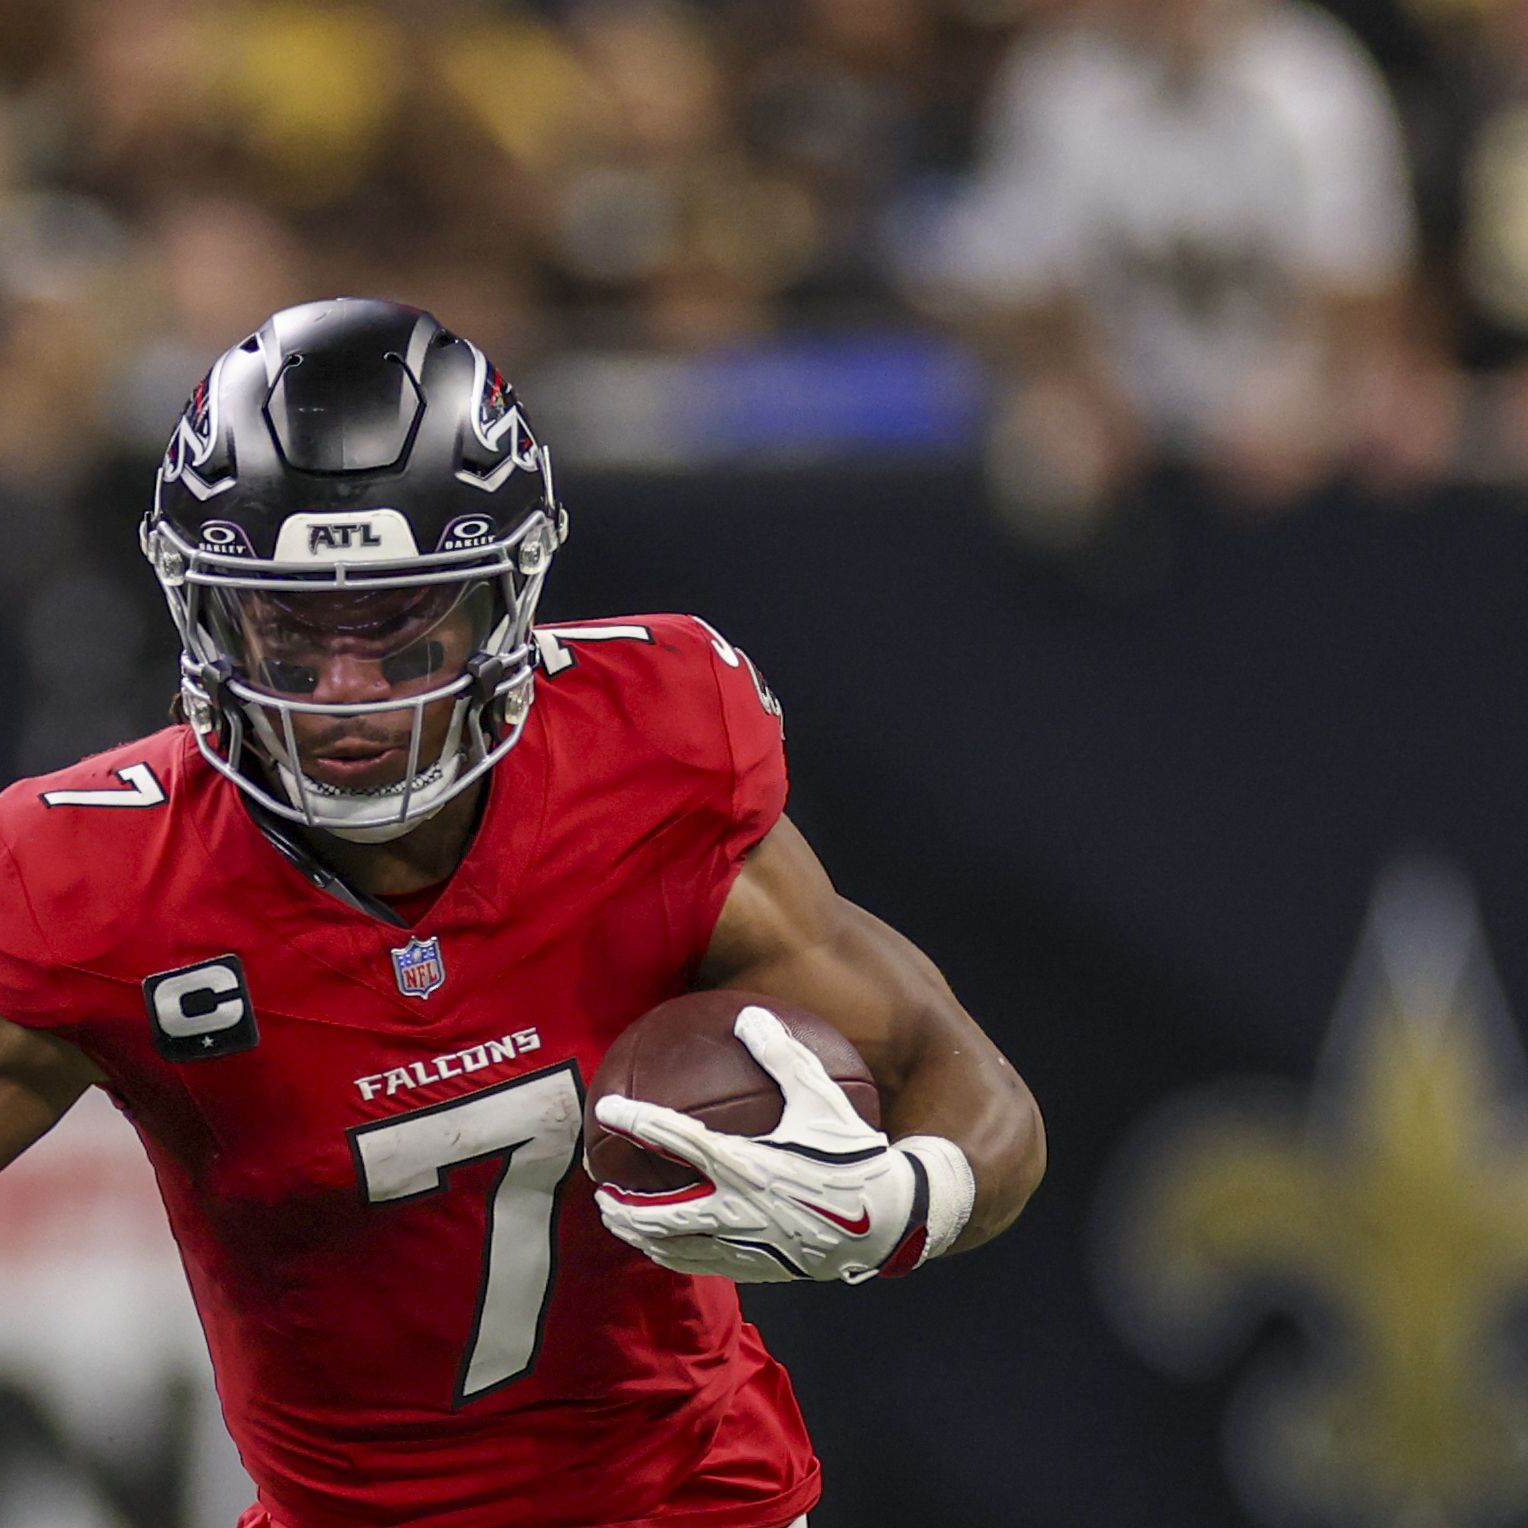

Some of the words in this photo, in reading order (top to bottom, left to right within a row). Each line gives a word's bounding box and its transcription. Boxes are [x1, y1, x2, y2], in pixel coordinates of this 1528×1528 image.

[307, 522, 382, 556] ATL
[443, 535, 497, 550] OAKLEY
[38, 761, 169, 809] 7
[403, 961, 439, 989] NFL
[153, 965, 245, 1038] C
[353, 1026, 542, 1102] FALCONS
[347, 1058, 584, 1408] 7
